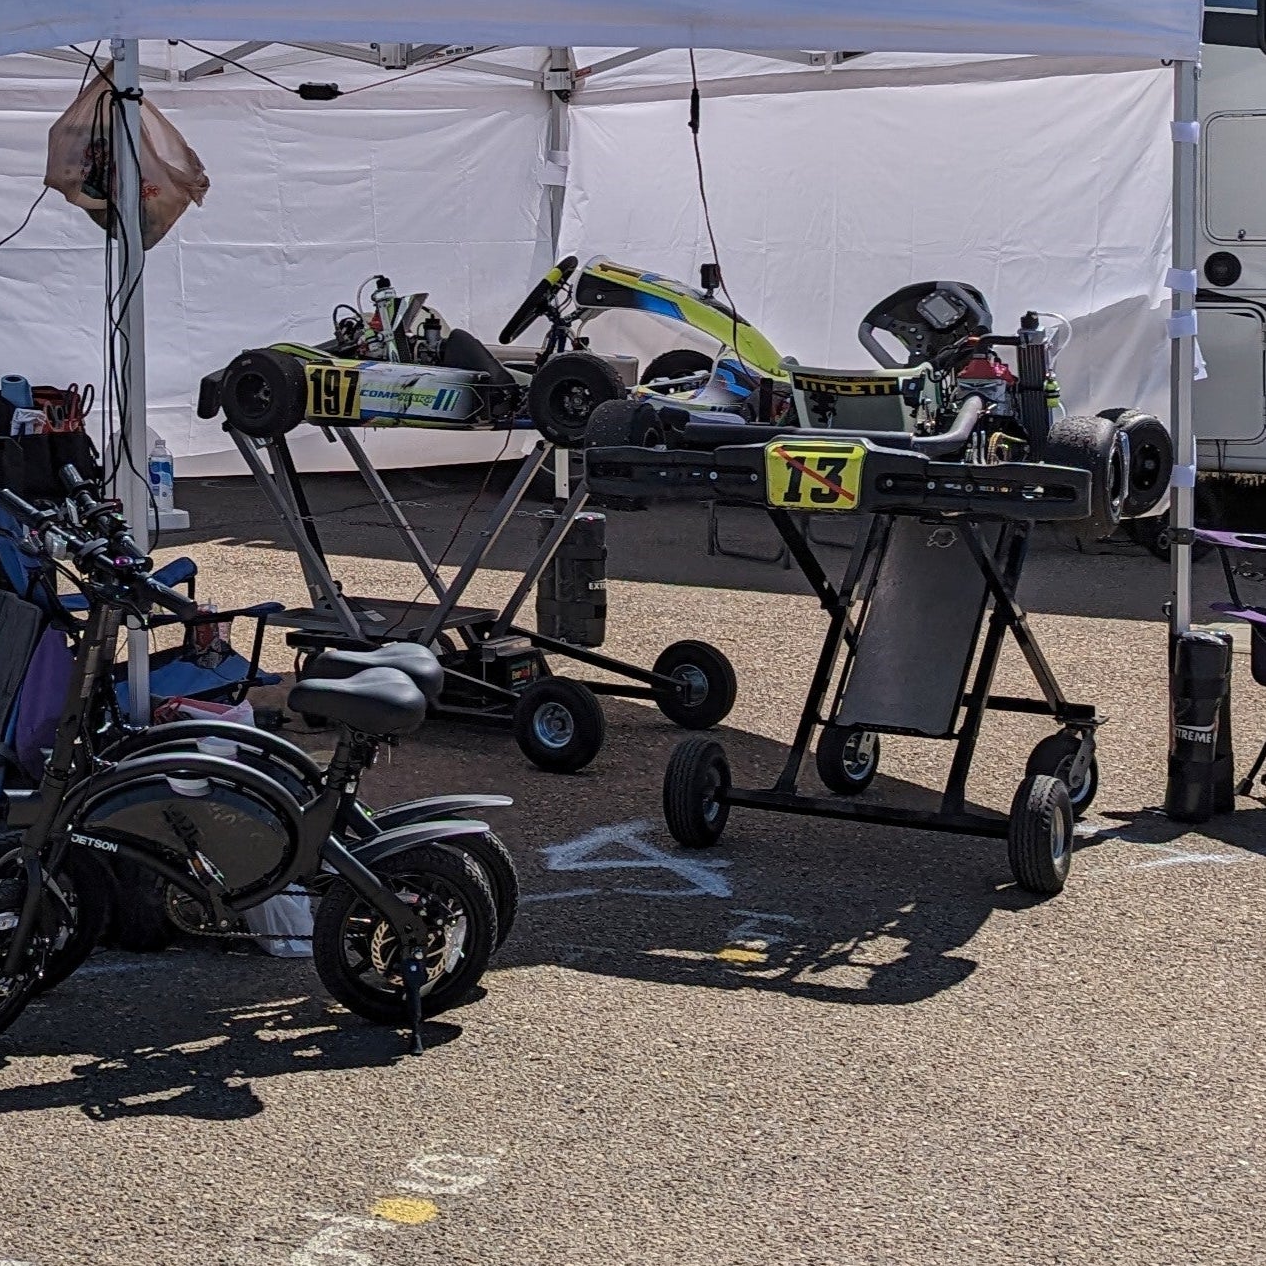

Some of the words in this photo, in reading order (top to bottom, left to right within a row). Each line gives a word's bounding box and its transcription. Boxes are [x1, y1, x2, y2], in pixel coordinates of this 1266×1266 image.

[310, 368, 360, 416] 197
[783, 456, 848, 503] 13
[71, 833, 118, 853] JETSON
